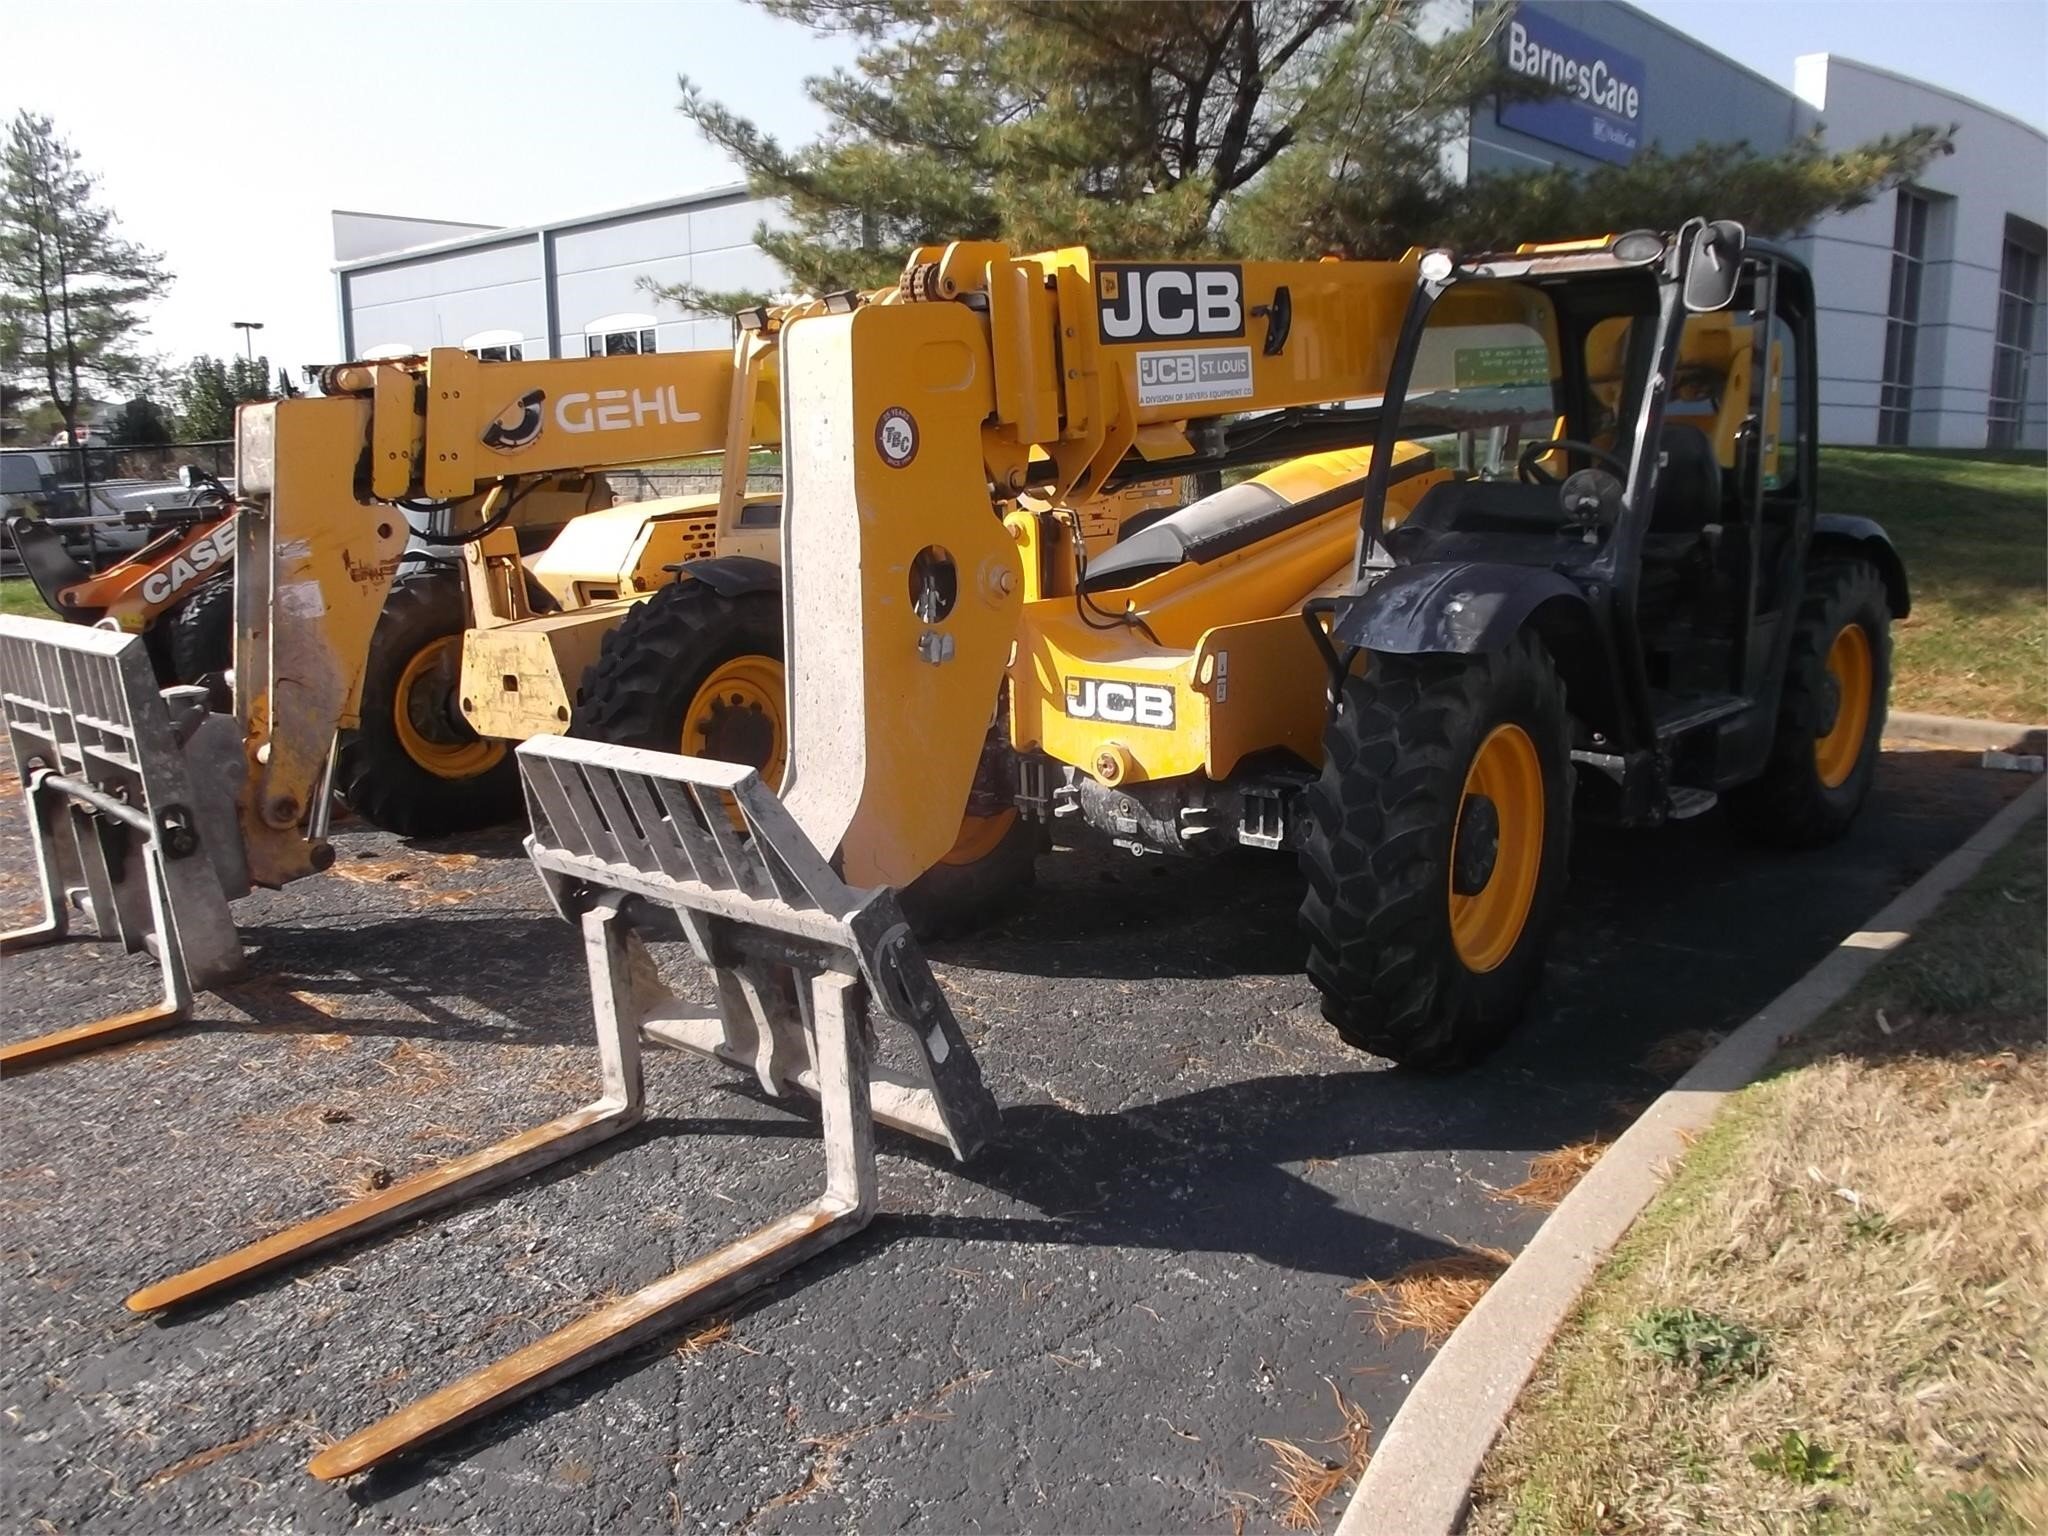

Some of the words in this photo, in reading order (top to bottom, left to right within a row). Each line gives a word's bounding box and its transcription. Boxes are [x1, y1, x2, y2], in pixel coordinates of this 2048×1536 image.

[1508, 21, 1639, 118] BarnesCare
[1102, 271, 1242, 337] JCB
[1143, 358, 1195, 383] JCB
[1201, 361, 1215, 375] ST.
[1217, 359, 1246, 374] LOUIS
[555, 385, 701, 434] GEHL
[1146, 393, 1174, 404] DIVISION
[1175, 393, 1184, 401] OF
[143, 522, 236, 604] CASE
[1067, 681, 1174, 727] JCB
